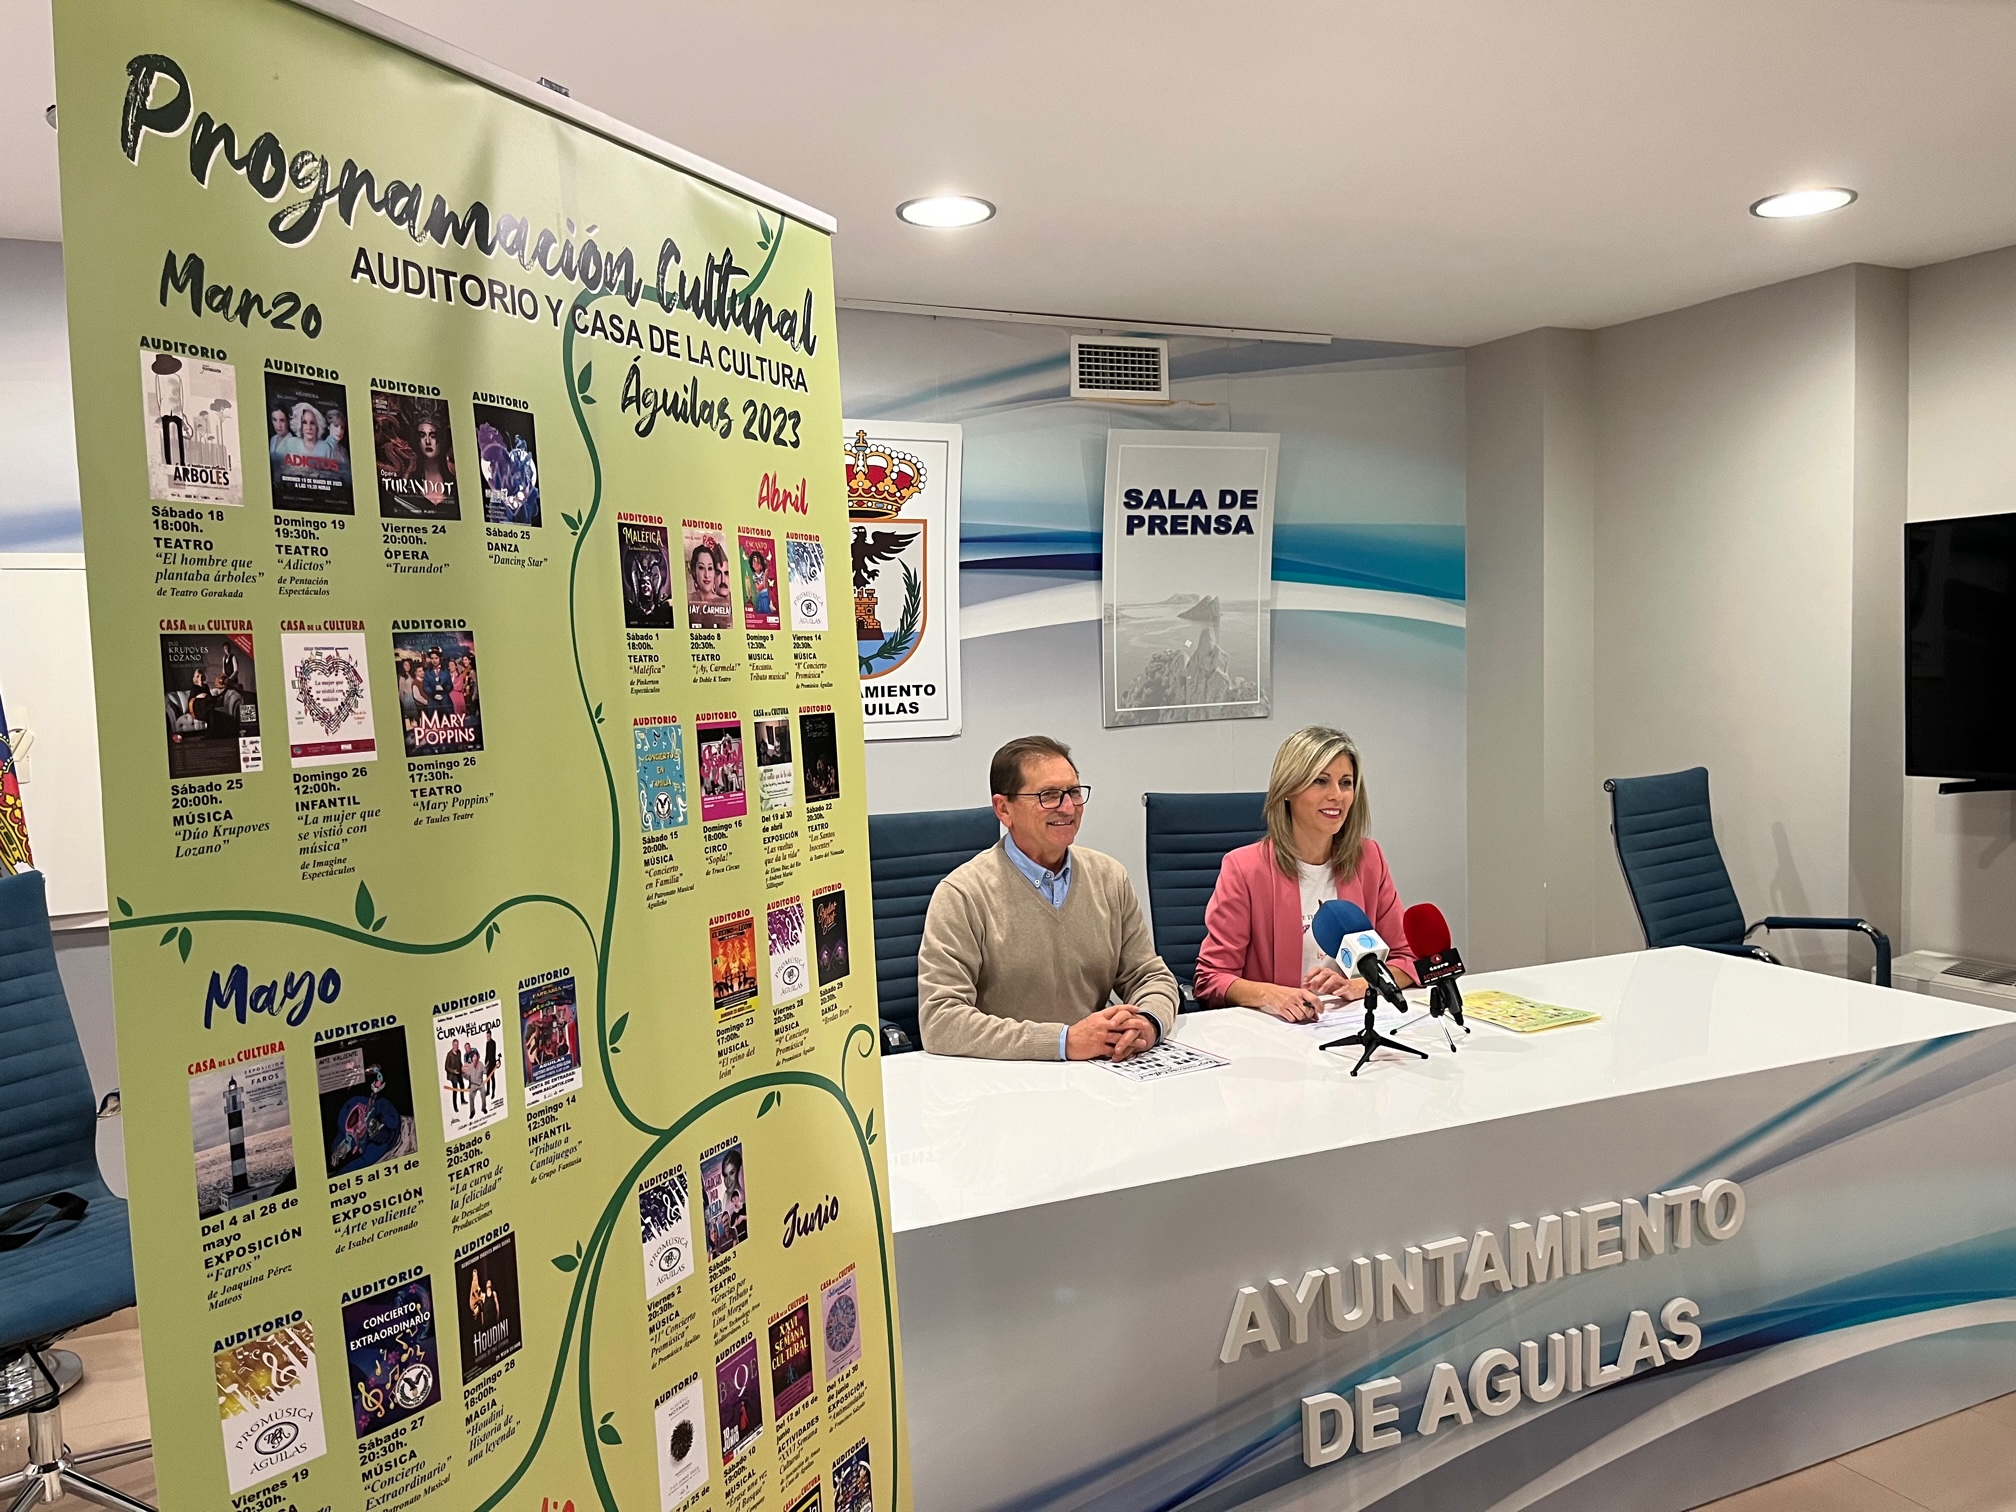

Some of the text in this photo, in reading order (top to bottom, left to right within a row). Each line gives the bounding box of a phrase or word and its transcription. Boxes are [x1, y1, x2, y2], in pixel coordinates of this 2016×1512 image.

[121, 53, 817, 358] Programación Cultural
[351, 246, 809, 392] AUDITORIO Y CASA DE LA CULTURA
[140, 336, 227, 361] AUDITORIO
[264, 358, 339, 380] AUDITORIO
[370, 377, 441, 396] AUDITORIO
[473, 392, 529, 410] AUDITORIO
[621, 355, 801, 449] Águilas 2023
[284, 453, 339, 470] ADICTOS
[173, 464, 230, 486] ÁRBOLES
[382, 477, 454, 495] TURANDOT
[758, 471, 808, 515] Abril
[1124, 488, 1259, 510] SALA DE
[151, 506, 224, 521] Sábado 18
[274, 515, 345, 530] Domingo 19
[617, 512, 663, 524] AUDITORIO
[153, 519, 203, 533] 18:00h.
[275, 528, 319, 540] 19:30h.
[381, 523, 446, 534] Viernes 24
[485, 527, 530, 540] Sábado 25
[682, 519, 723, 531] AUDITORIO
[1126, 514, 1254, 536] PRENSA
[153, 537, 214, 551] TEATRO
[383, 535, 427, 545] 20:00h.
[623, 527, 664, 547] MALÉFICA
[275, 545, 329, 556] TEATRO
[384, 548, 429, 560] ÓPERA
[487, 542, 519, 553] DANZA
[180, 554, 227, 568] hombre
[231, 559, 253, 574] que
[155, 568, 210, 583] plantaba
[157, 588, 243, 598] de Teatro Gorakada
[160, 620, 186, 631] CASA
[207, 620, 253, 631] CULTURA
[281, 621, 305, 631] CASA
[323, 621, 365, 631] CULTURA
[392, 619, 466, 629] AUDITORIO
[626, 633, 653, 641] Sábado
[627, 642, 653, 650] 18:00h.
[690, 633, 721, 641] Sábado 8
[690, 642, 715, 650] 20:30h.
[169, 654, 201, 662] LOZANO
[628, 655, 659, 663] TEATRO
[691, 654, 721, 662] TEATRO
[861, 684, 936, 698] MIENTO
[421, 711, 466, 729] MARY
[633, 716, 677, 726] AUDITORIO
[414, 728, 475, 746] POPPINS
[408, 757, 476, 772] Domingo 26
[293, 767, 368, 785] Domingo 26
[409, 772, 453, 783] 17:30h.
[171, 779, 243, 795] Sábado 25
[294, 783, 340, 795] 12:00h.
[410, 785, 462, 798] TEATRO
[172, 796, 222, 809] 20:00h.
[296, 796, 360, 811] INFANTIL
[173, 810, 233, 826] MÚSICA
[322, 811, 357, 825] mujer
[360, 809, 381, 822] que
[213, 821, 270, 839] Krupoves
[298, 824, 367, 841] se vistió con
[703, 823, 732, 833] Domingo
[642, 834, 668, 844] Sábado
[704, 844, 727, 854] CIRCO
[204, 963, 342, 1030] Mayo
[432, 990, 496, 1015] AUDITORIO
[314, 1015, 397, 1043] AUDITORIO
[188, 1059, 216, 1075] CASA
[237, 1041, 285, 1062] CULTURA
[251, 1073, 279, 1085] FAROS
[446, 1131, 491, 1156] Sábado 6
[447, 1148, 483, 1168] 20:30h.
[328, 1158, 419, 1194] Del 5 al 31 de
[448, 1158, 490, 1183] TEATRO
[330, 1190, 367, 1209] mayo
[332, 1187, 423, 1225] EXPOSICIÓN
[201, 1197, 298, 1237] Del 4 al 28 de
[783, 1194, 839, 1248] Junio
[202, 1233, 241, 1252] mayo
[204, 1226, 302, 1269] EXPOSICIÓN
[454, 1222, 510, 1260] AUDITORIO
[1219, 1178, 1746, 1364] AYUNTAMIENTO
[341, 1265, 423, 1304] AUDITORIO
[363, 1302, 416, 1330] CONCIERTO
[213, 1310, 303, 1353] AUDITORIO
[350, 1312, 431, 1351] EXTRAORDINARIO
[772, 1337, 808, 1371] CULTURAL
[464, 1369, 502, 1400] Domingo
[505, 1359, 515, 1371] 28
[1302, 1297, 1702, 1468] DE AGUILAS
[465, 1387, 497, 1411] 18:00h.
[465, 1399, 497, 1427] MAGIA
[235, 1408, 314, 1450] PROMÚSICA
[358, 1416, 424, 1455] Sábado 27
[250, 1443, 307, 1475] ÁGUILAS
[360, 1441, 407, 1467] 20:30h.
[362, 1449, 417, 1482] MÚSICA
[232, 1468, 309, 1509] Viernes 19
